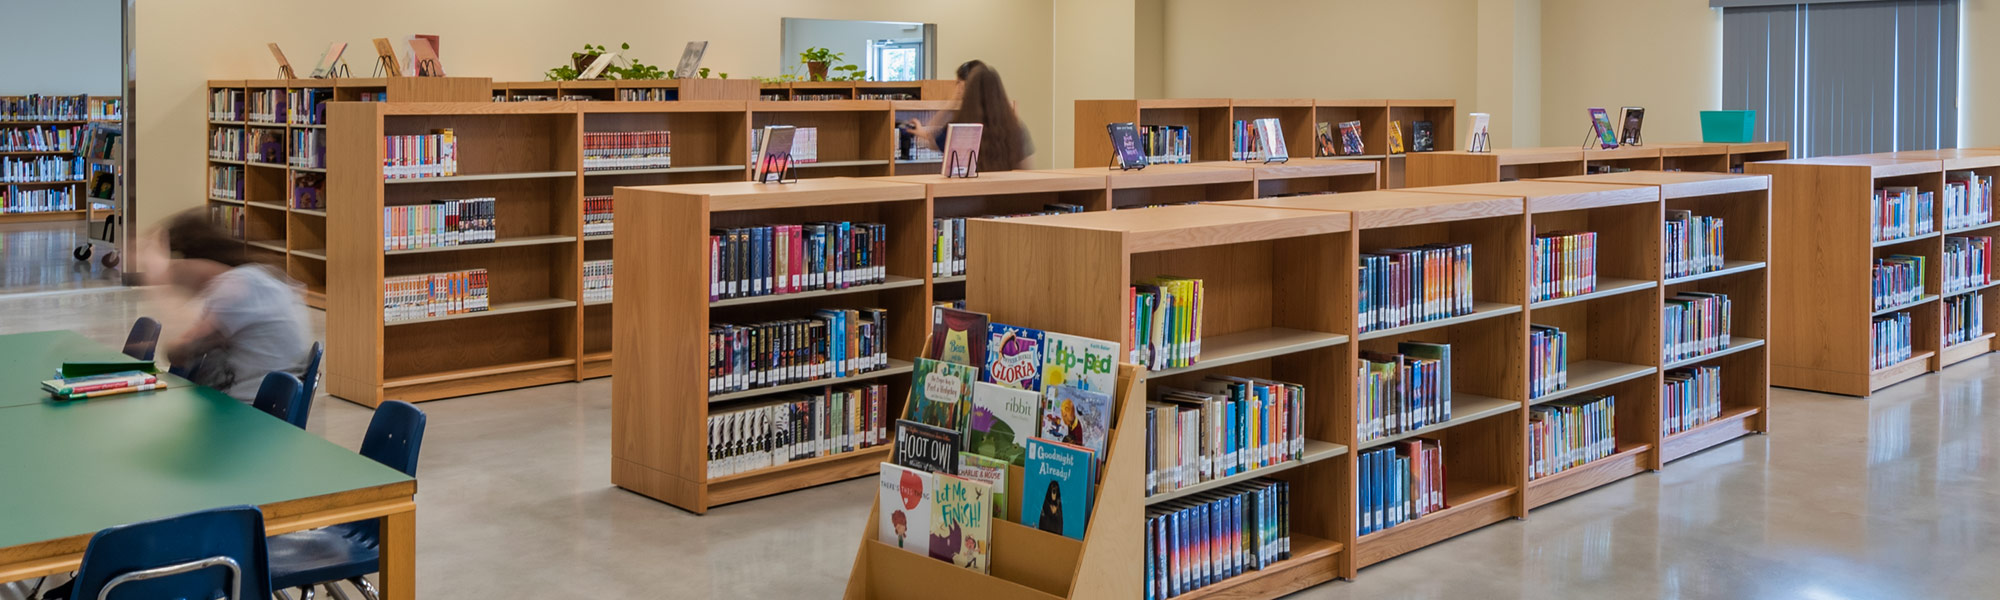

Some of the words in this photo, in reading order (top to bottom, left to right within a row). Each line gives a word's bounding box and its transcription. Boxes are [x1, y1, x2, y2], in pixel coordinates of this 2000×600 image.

[992, 361, 1035, 383] GLORIA
[1005, 396, 1031, 416] ribbit
[899, 433, 930, 465] HOOT
[1037, 446, 1074, 466] Goodnight
[1039, 462, 1071, 481] Already!
[936, 483, 951, 504] Let
[953, 481, 967, 502] Me
[942, 501, 981, 528] FINISH!
